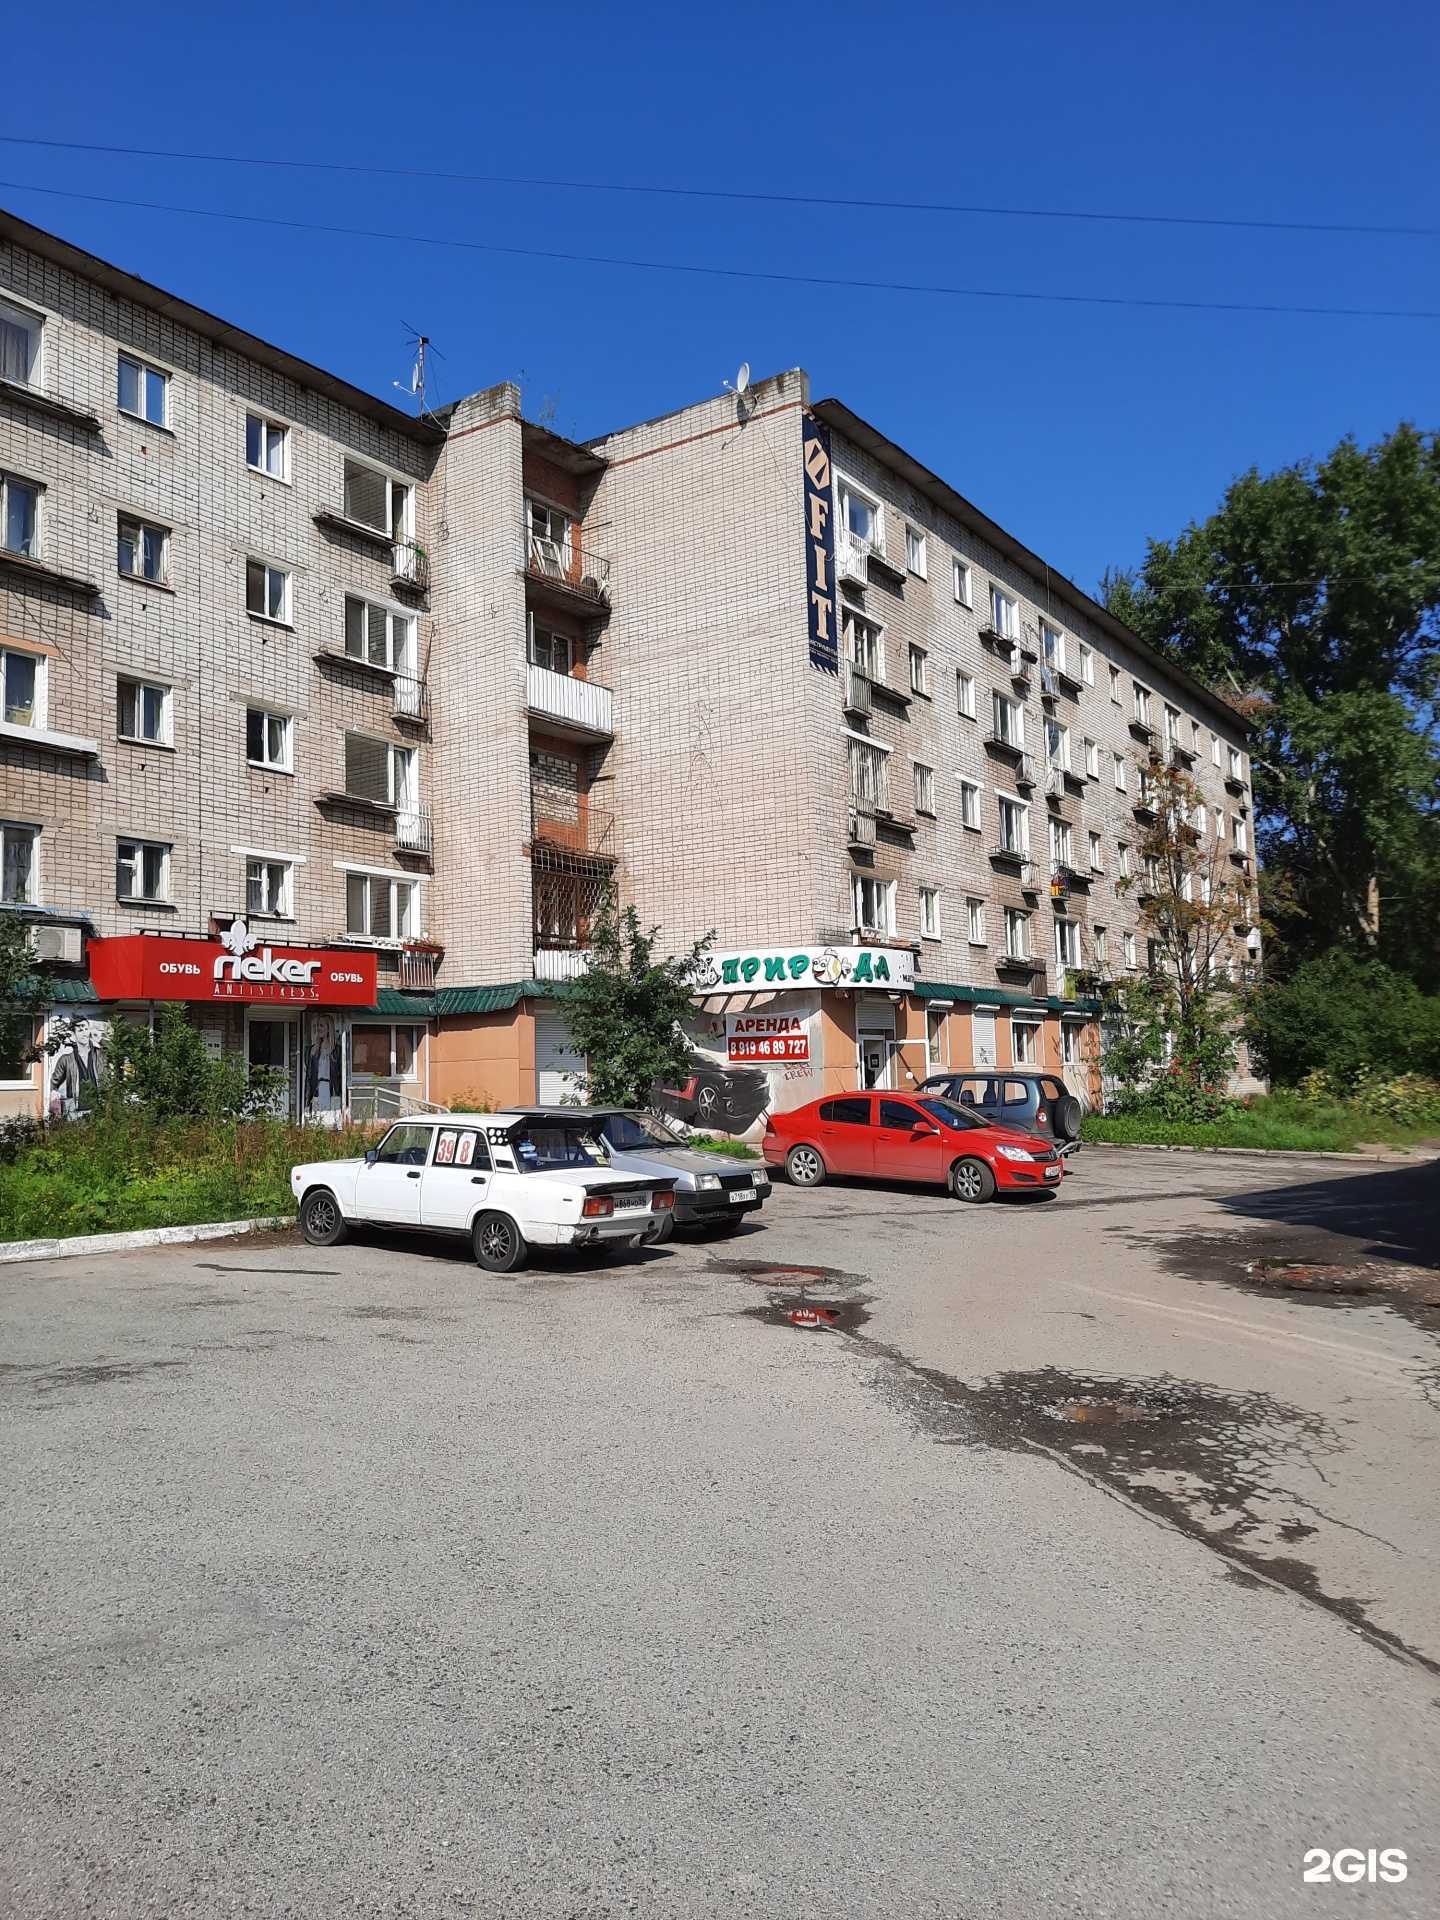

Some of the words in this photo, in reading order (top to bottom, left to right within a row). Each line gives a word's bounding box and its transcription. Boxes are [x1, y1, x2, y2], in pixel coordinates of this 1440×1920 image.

[808, 492, 832, 641] FIT
[159, 962, 201, 975] ОБУВЬ
[213, 948, 321, 984] rieker
[330, 972, 364, 983] ОБУВЬ
[735, 1017, 801, 1033] АРЕНДА
[730, 1041, 737, 1056] 8
[739, 1041, 756, 1056] 919
[758, 1040, 771, 1055] 46
[773, 1040, 785, 1055] 89
[787, 1040, 806, 1054] 727
[438, 1139, 455, 1162] 39
[460, 1141, 471, 1163] 8
